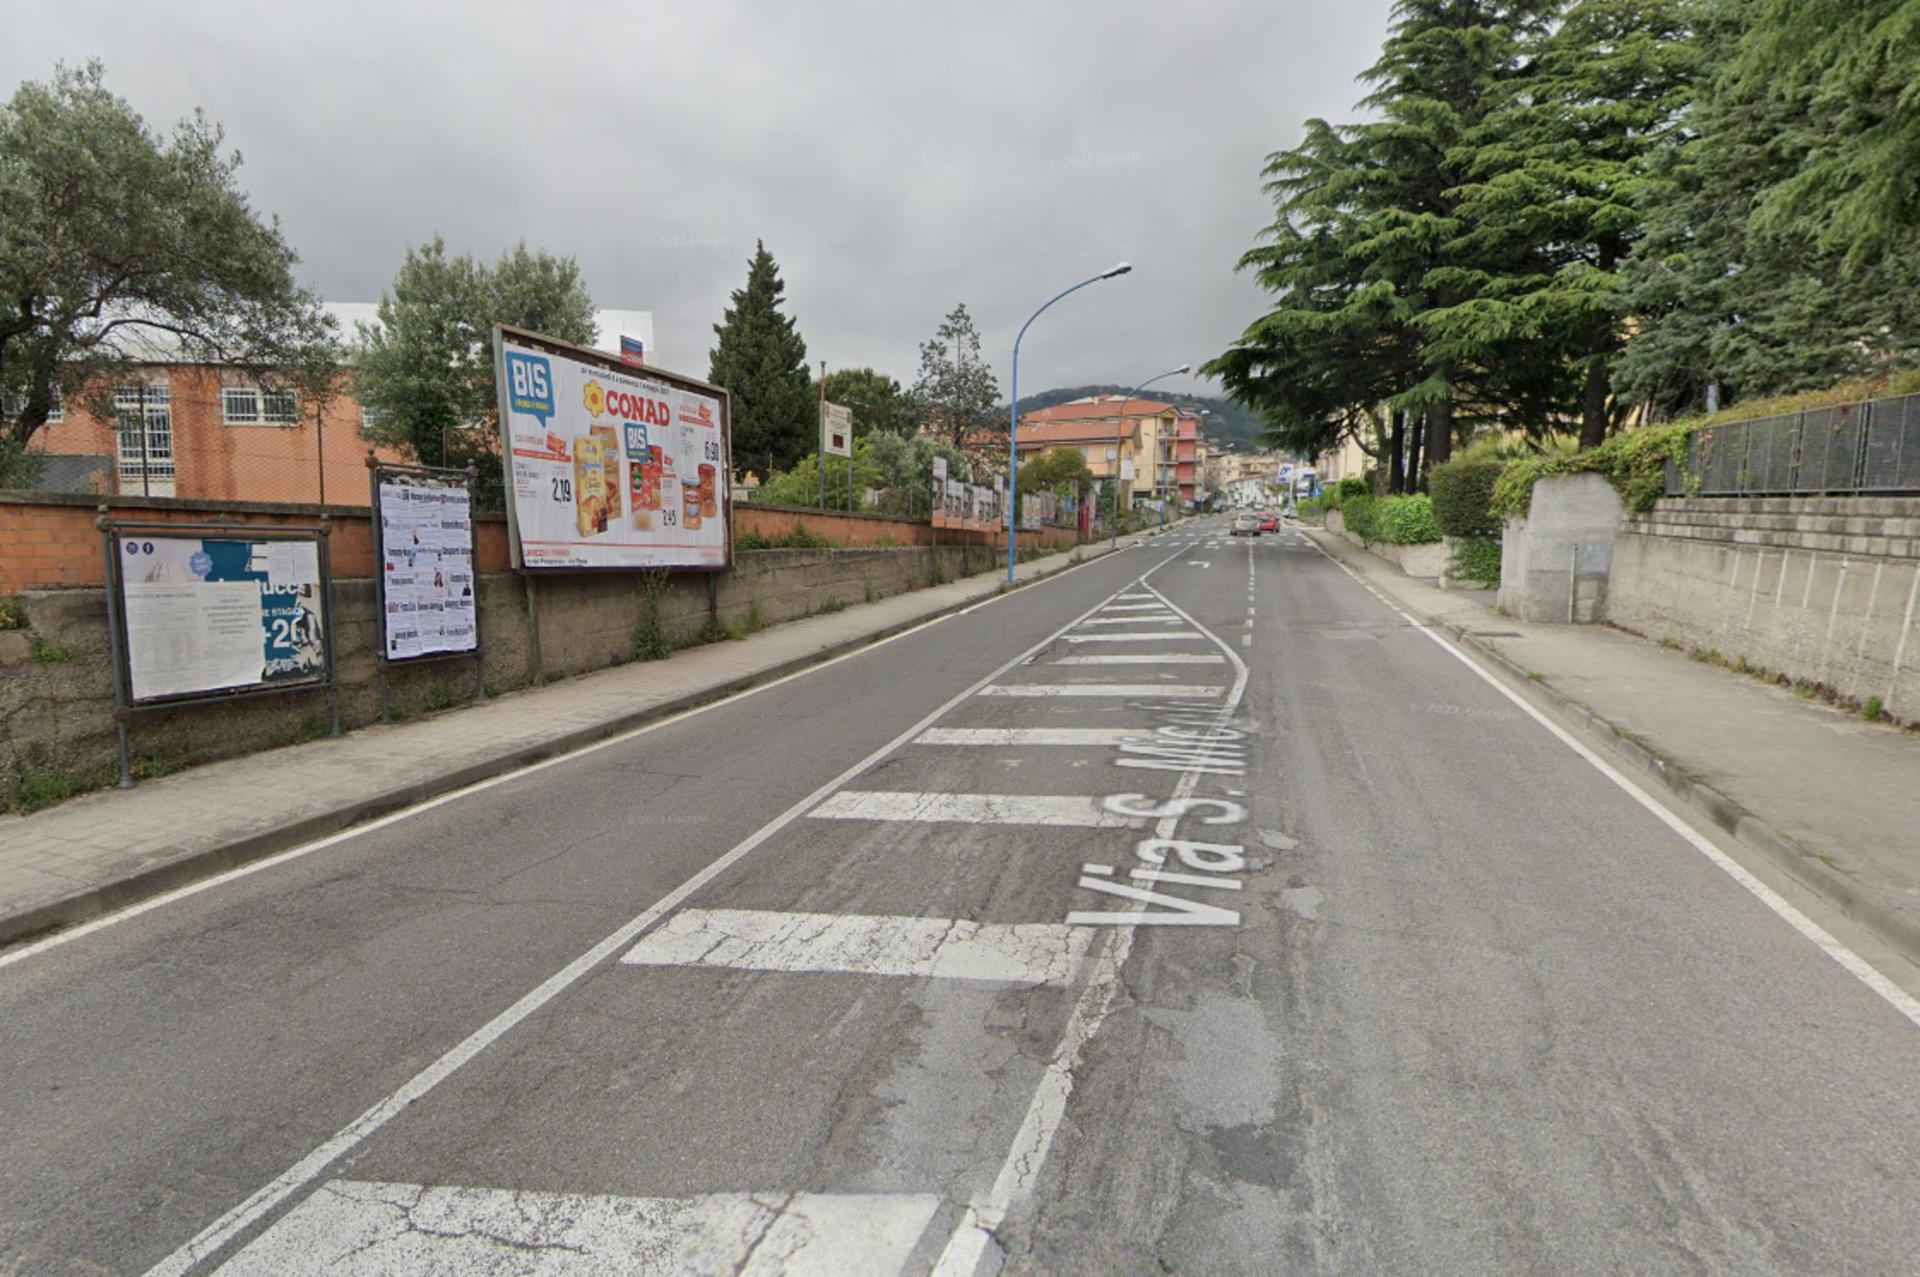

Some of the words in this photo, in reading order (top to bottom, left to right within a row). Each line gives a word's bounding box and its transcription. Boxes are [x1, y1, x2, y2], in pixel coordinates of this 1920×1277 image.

[512, 359, 548, 399] BIS
[606, 390, 670, 427] CONAD
[627, 428, 646, 449] BIS
